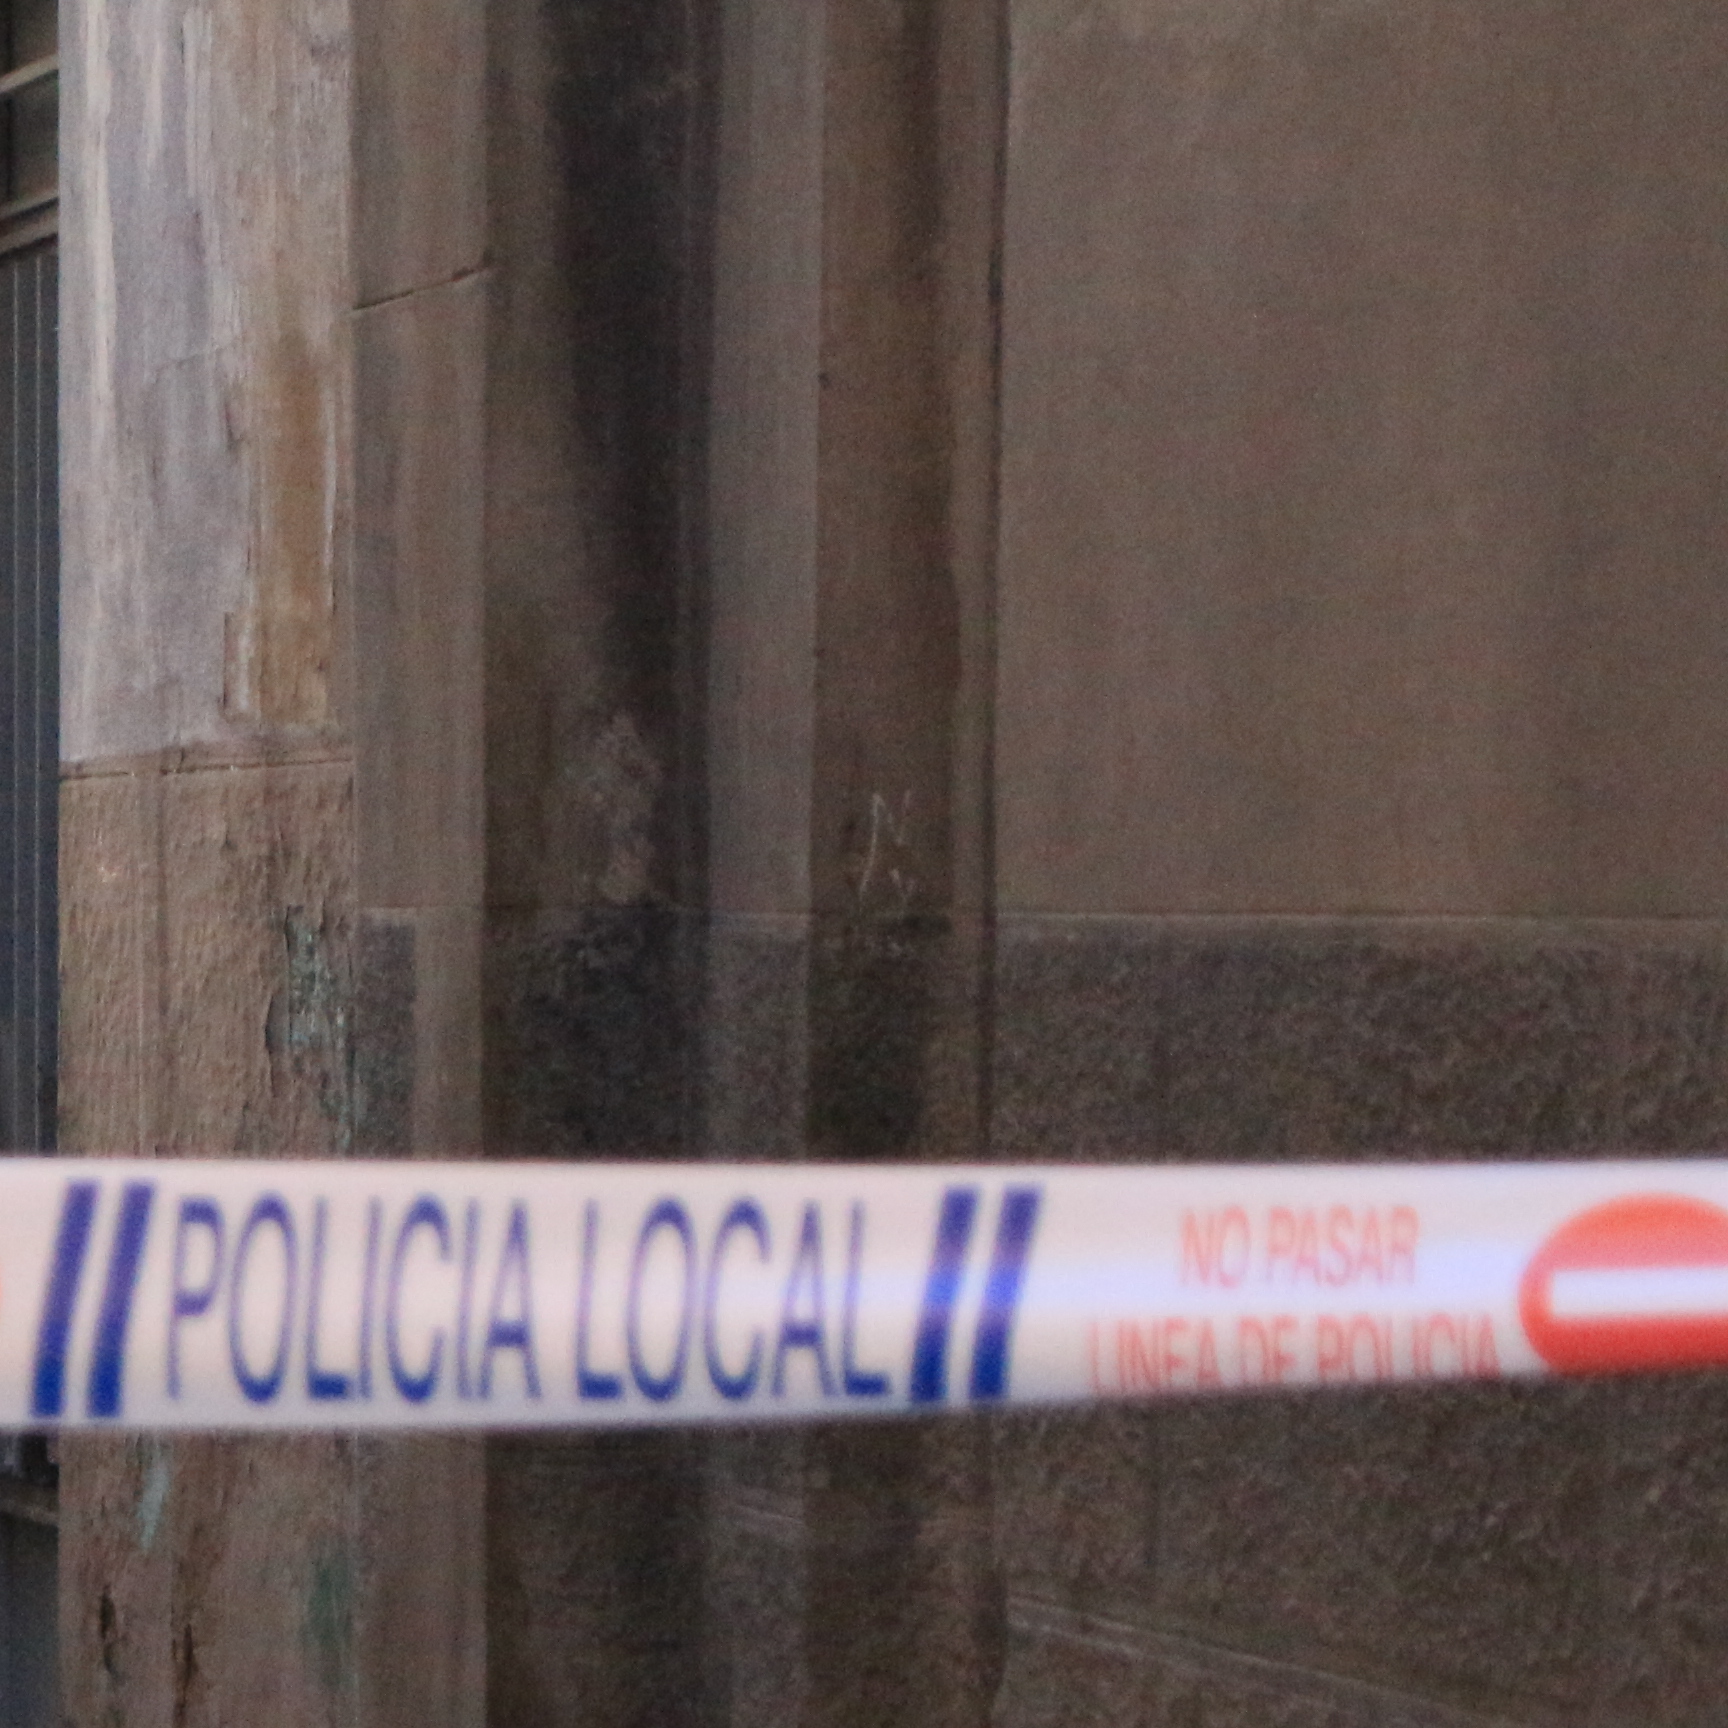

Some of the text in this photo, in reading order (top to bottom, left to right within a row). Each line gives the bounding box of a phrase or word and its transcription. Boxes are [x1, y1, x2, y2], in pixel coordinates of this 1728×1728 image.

[166, 1192, 892, 1402] POLICIA LOCAL
[1179, 1205, 1420, 1288] NO PASAR
